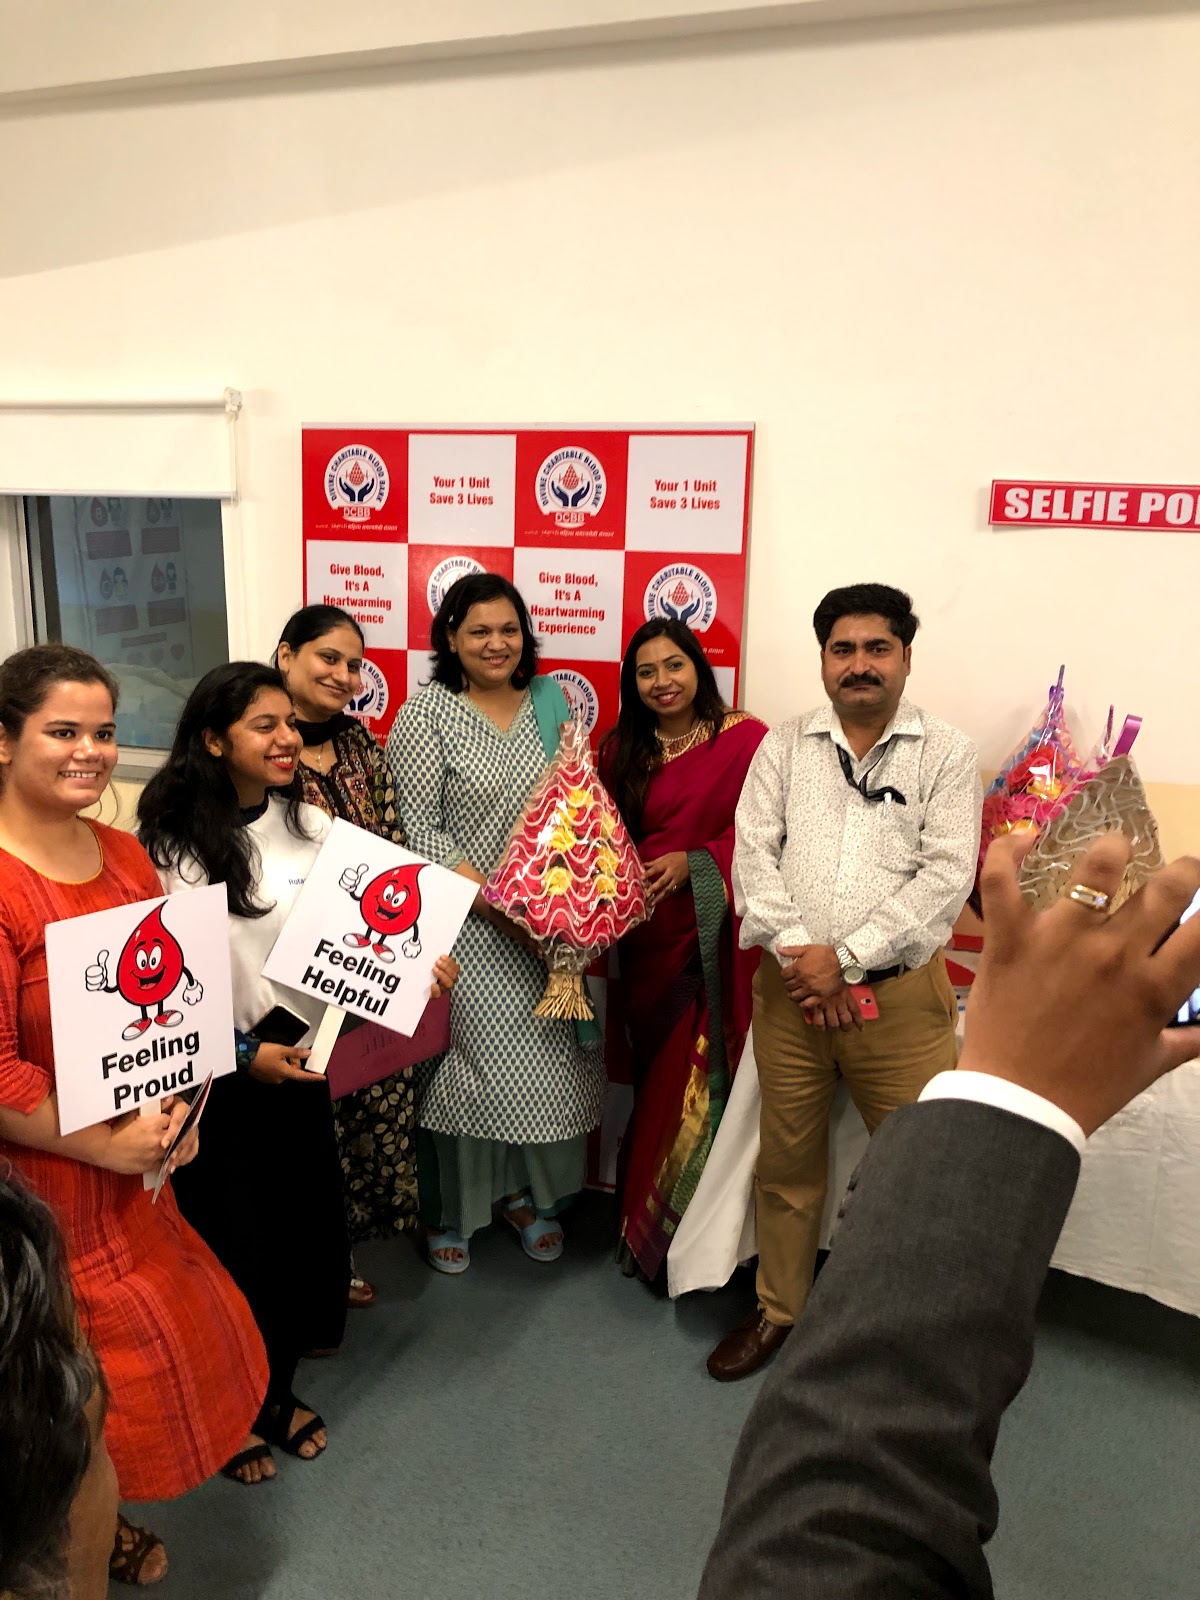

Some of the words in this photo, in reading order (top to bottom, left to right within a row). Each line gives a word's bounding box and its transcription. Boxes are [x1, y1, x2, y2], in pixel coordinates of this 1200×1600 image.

[331, 448, 368, 471] CHARITABLE
[368, 453, 384, 477] BLOOD
[543, 450, 584, 475] CHARITABLE
[584, 455, 601, 481] BLOOD
[329, 474, 337, 502] DIVINE
[376, 480, 386, 503] BANK
[433, 476, 456, 488] Your
[459, 476, 464, 488] 1
[469, 476, 490, 489] Unit
[538, 477, 547, 507] DIVINE
[655, 479, 679, 492] Your
[683, 479, 689, 492] 1
[694, 479, 717, 492] Unit
[430, 492, 454, 505] Save
[457, 492, 464, 505] 3
[467, 493, 494, 505] Lives
[591, 484, 602, 508] BANK
[650, 496, 677, 509] Save
[680, 496, 687, 509] 3
[691, 497, 720, 509] Lives
[1004, 487, 1129, 523] SELFIE
[343, 506, 371, 517] DCBB
[555, 512, 584, 522] DCBB
[330, 563, 351, 575] Give
[354, 564, 385, 578] Blood,
[433, 559, 472, 582] CHARITABLE
[539, 571, 561, 584] Give
[565, 573, 598, 587] Blood,
[651, 566, 694, 591] CHARITABLE
[345, 580, 360, 591] It's
[363, 580, 370, 591] A
[555, 589, 571, 601] It's
[574, 590, 581, 601] A
[694, 572, 712, 598] BLOOD
[323, 594, 391, 611] Heartwarming
[530, 604, 605, 621] Heartwarming
[701, 600, 712, 625] BANK
[538, 621, 596, 635] Experience
[367, 665, 383, 689] BLOOD
[376, 691, 385, 713] BANK
[577, 678, 594, 703] BLOOD
[585, 705, 596, 728] BANK
[313, 938, 402, 995] Feeling
[301, 964, 390, 1016] Helpful
[101, 1030, 200, 1080] Feeling
[113, 1060, 194, 1110] Proud
